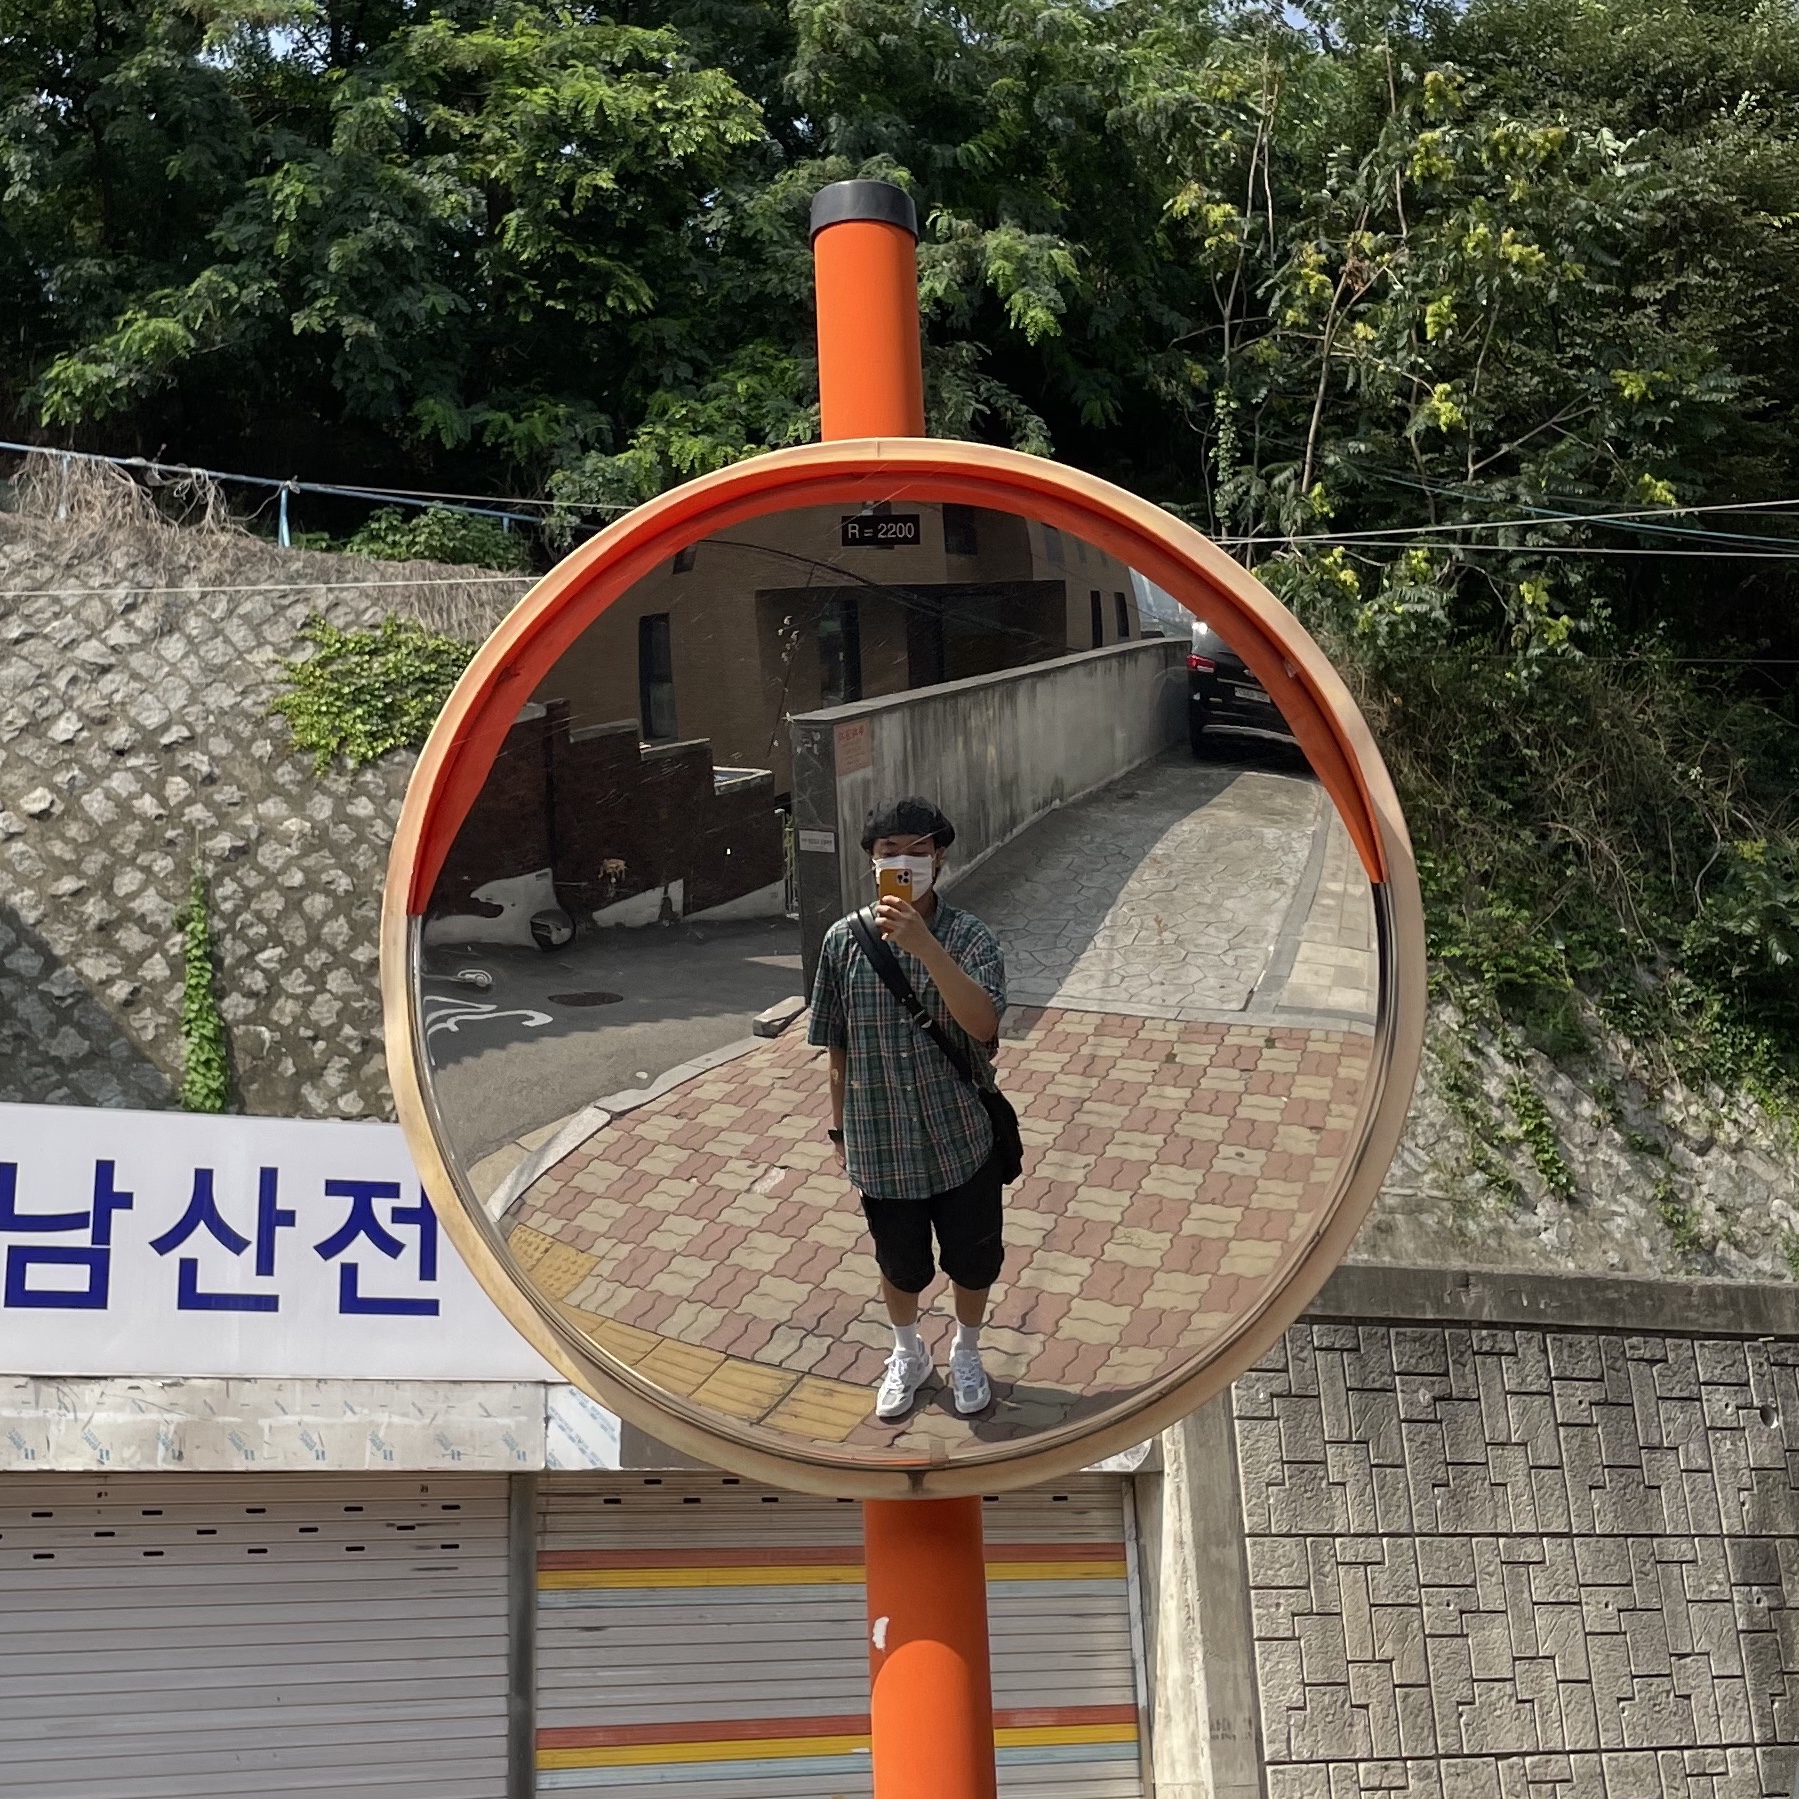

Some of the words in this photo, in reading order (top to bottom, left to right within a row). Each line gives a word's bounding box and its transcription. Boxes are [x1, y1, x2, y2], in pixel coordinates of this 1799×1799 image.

[848, 523, 859, 538] R
[878, 523, 914, 538] 2200
[0, 1159, 440, 1316] 남산전
